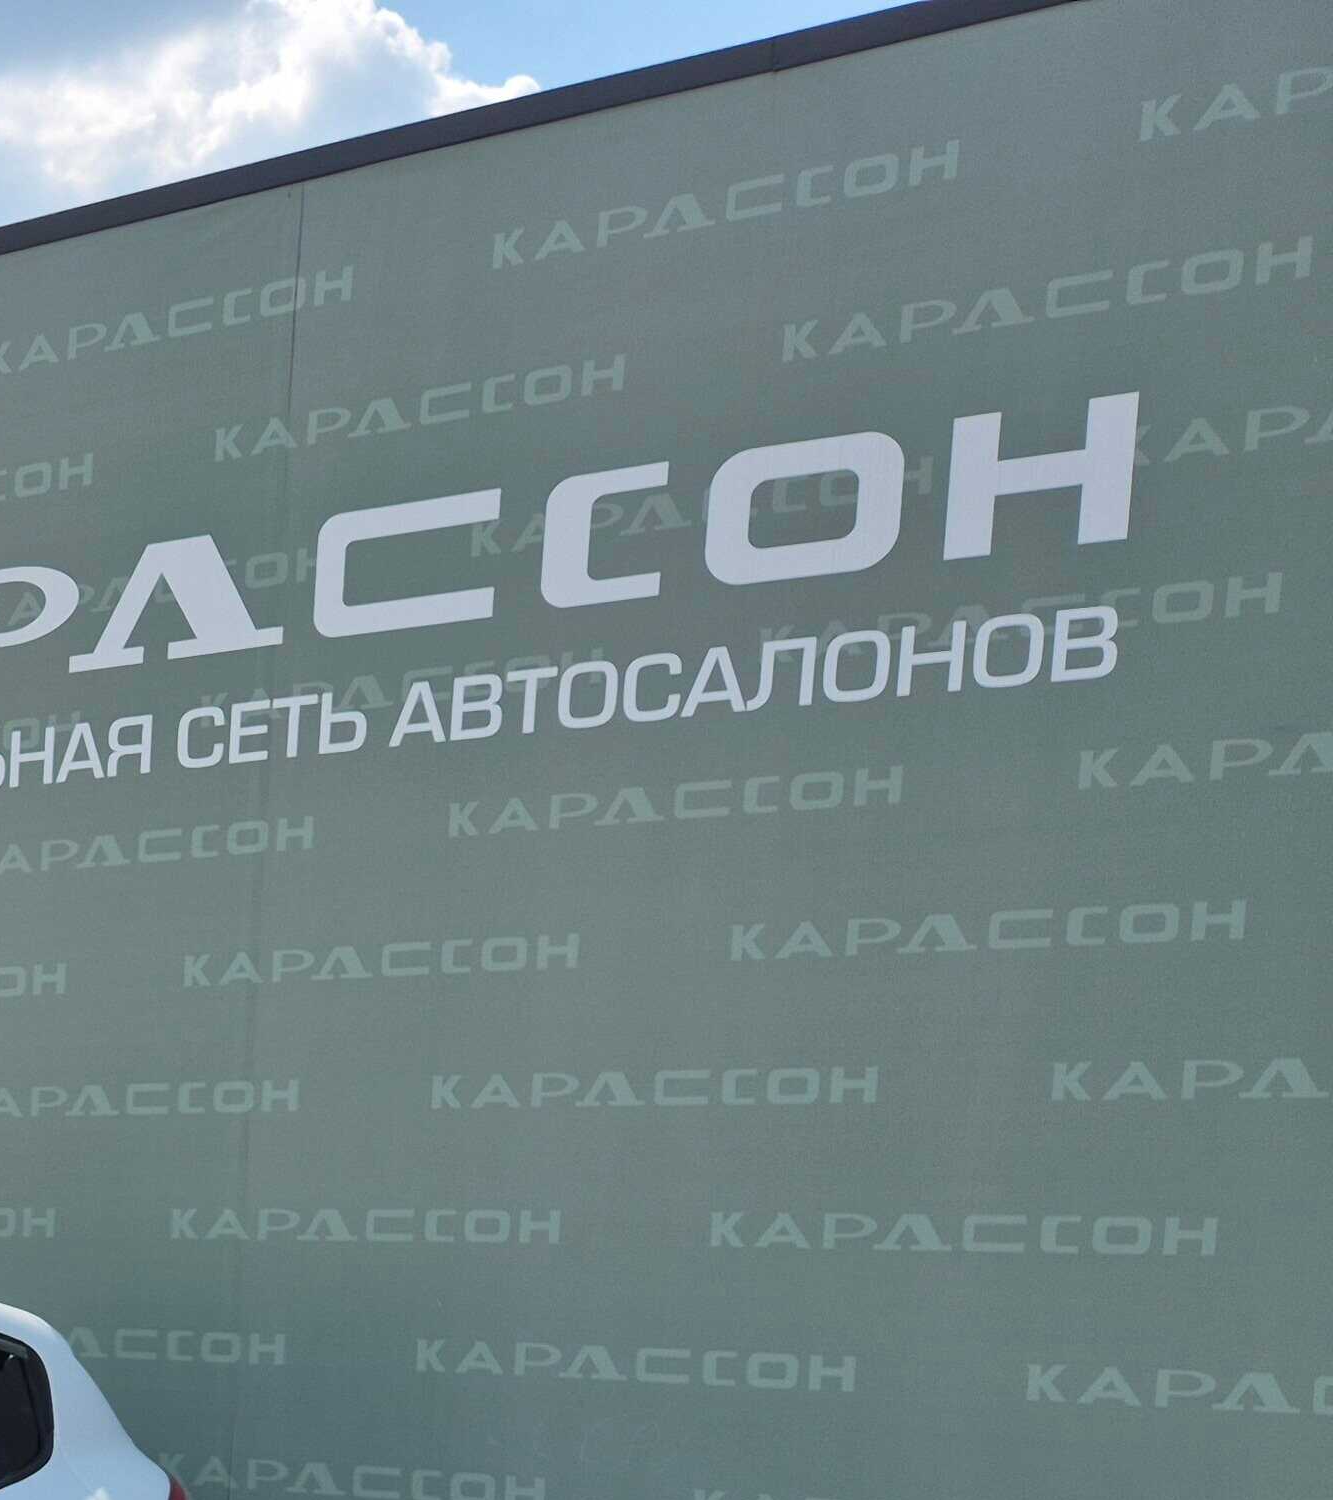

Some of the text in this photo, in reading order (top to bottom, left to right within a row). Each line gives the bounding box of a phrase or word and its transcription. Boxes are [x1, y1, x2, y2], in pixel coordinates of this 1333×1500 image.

[492, 139, 960, 269] КАРАССОН
[782, 236, 1313, 362] КАРАССОН
[213, 354, 626, 462] КАРАССОН
[177, 692, 367, 769] СЕТЬ
[389, 605, 1119, 747] АВТОСАЛОНОВ
[448, 765, 903, 837] КАРАССОН
[182, 933, 579, 987] КАРАССОН
[731, 900, 1247, 962] КАРАССОН
[431, 1066, 878, 1110] КАРАССОН
[170, 1207, 561, 1245] КАРАССОН
[709, 1211, 1218, 1256] КАРАССОН
[416, 1338, 856, 1392] КАРАССОН
